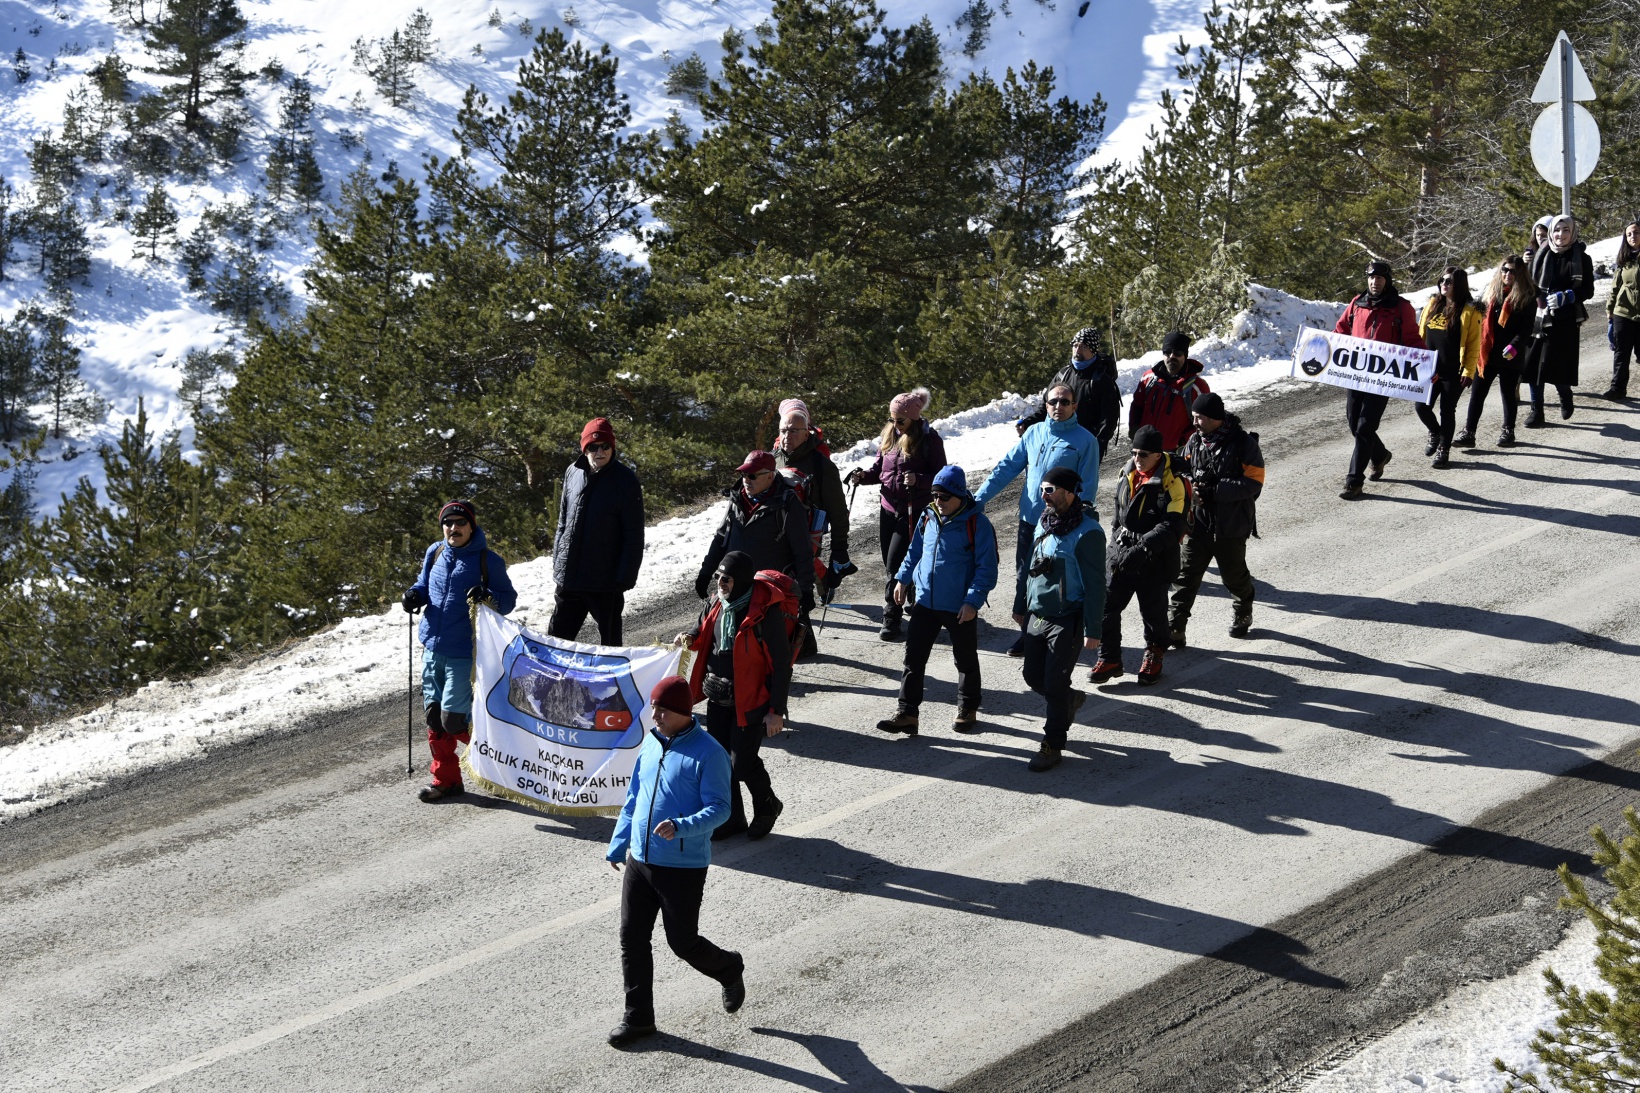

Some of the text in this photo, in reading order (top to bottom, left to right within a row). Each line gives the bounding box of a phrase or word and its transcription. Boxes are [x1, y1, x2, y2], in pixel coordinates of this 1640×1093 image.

[1332, 346, 1421, 382] GÜDAK
[1327, 368, 1352, 380] Gümüşhane
[1376, 378, 1388, 388] Doğa
[536, 721, 579, 744] KDRK
[538, 748, 584, 771] KAÇKAR
[521, 759, 567, 786] RAFTİNG
[516, 776, 550, 798] SPOR
